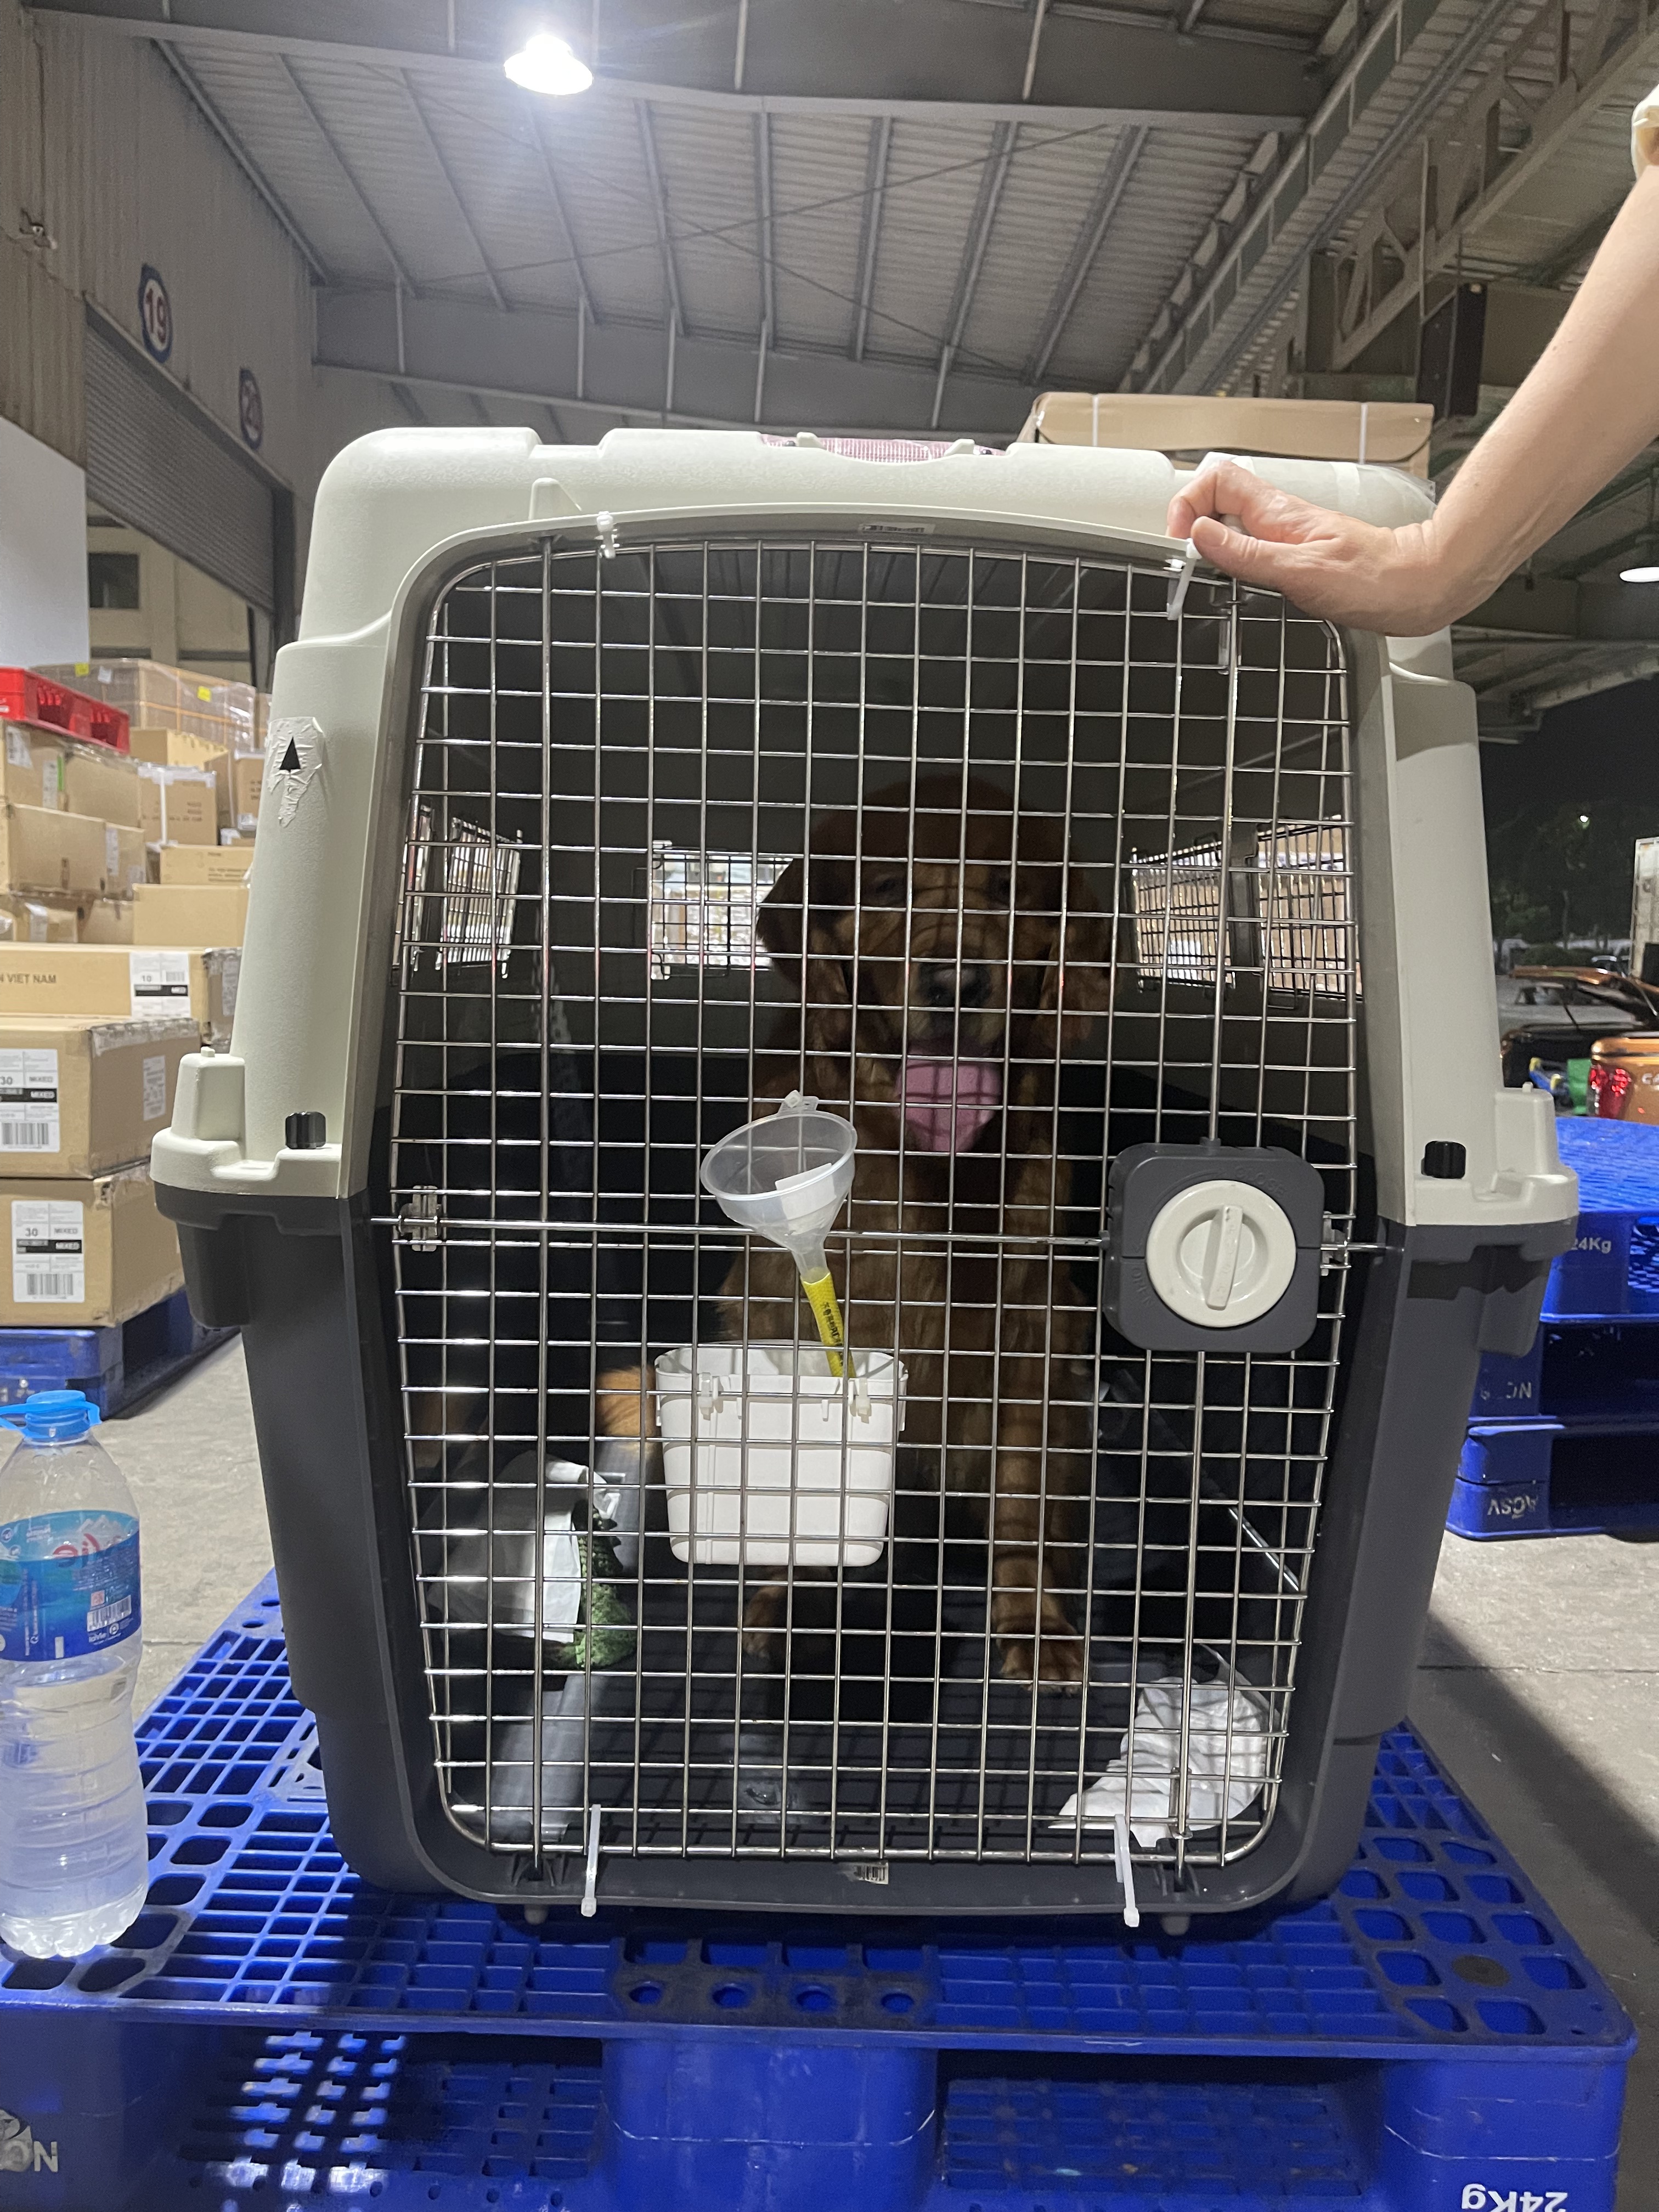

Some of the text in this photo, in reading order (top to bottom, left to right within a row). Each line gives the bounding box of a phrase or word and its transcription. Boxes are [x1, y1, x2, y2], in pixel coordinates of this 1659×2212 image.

[146, 288, 166, 344] 19
[33, 974, 57, 984] NAM
[1235, 1165, 1285, 1197] CLOSE
[25, 1227, 38, 1237] 30
